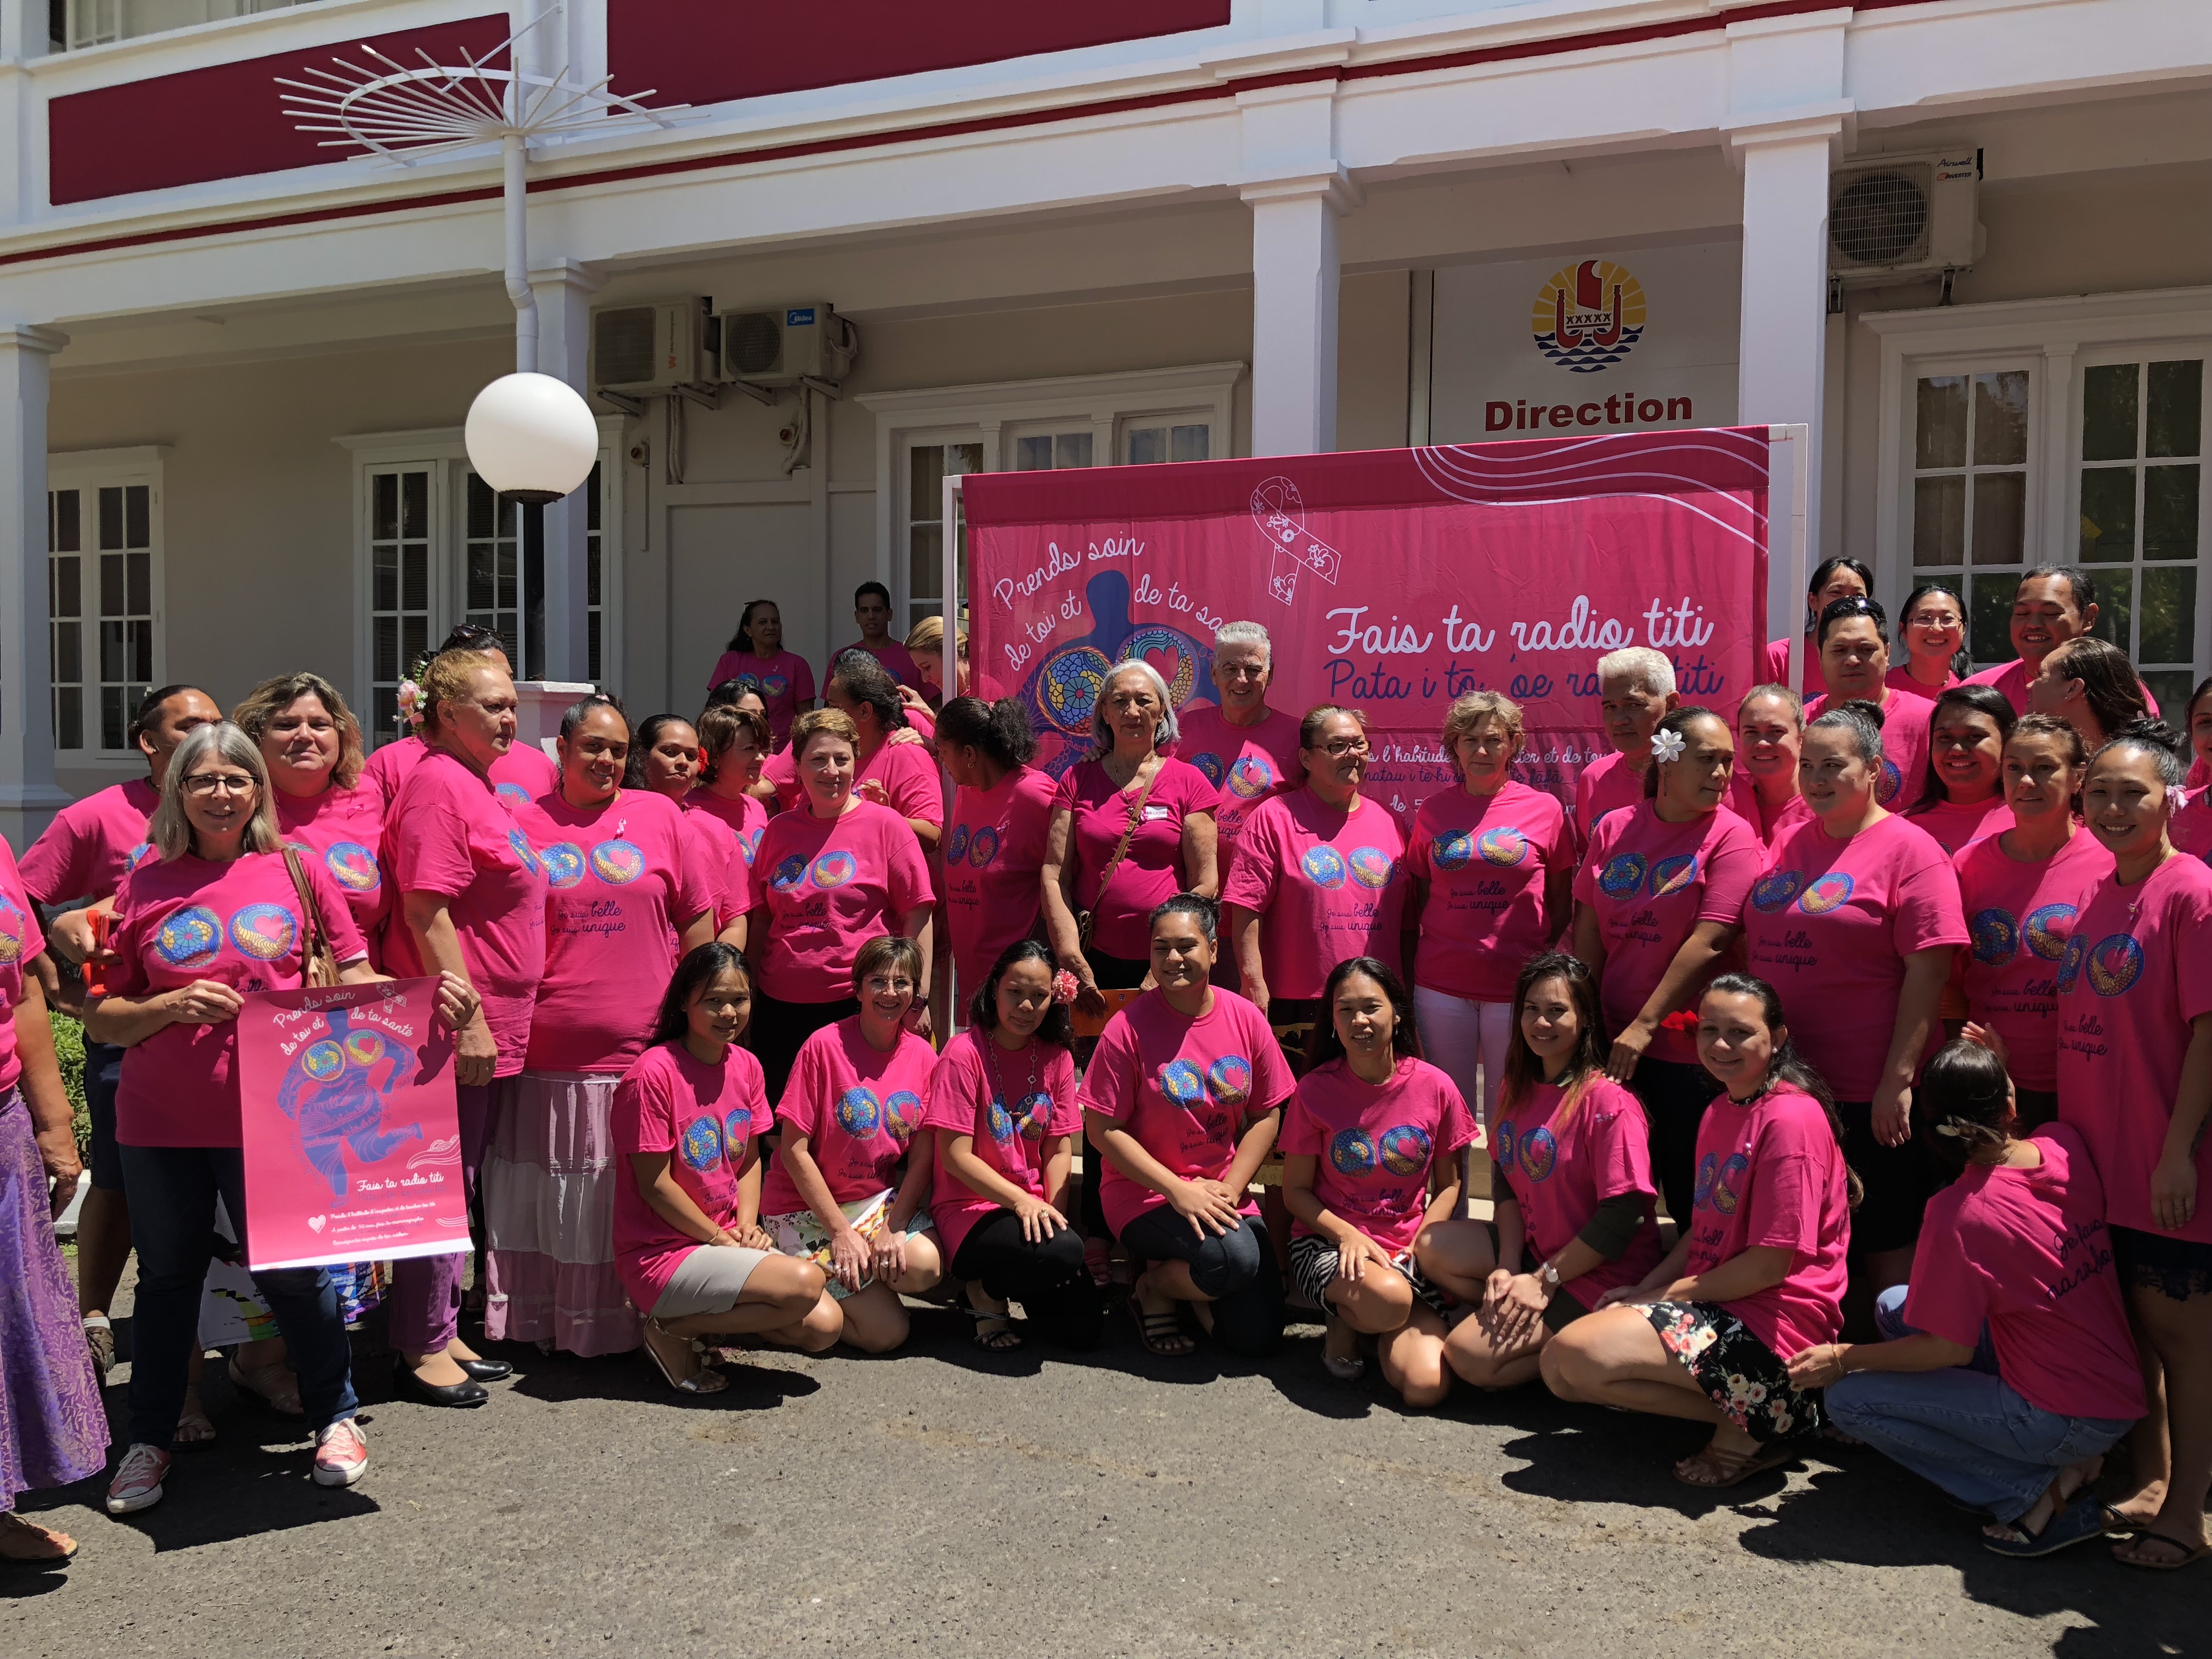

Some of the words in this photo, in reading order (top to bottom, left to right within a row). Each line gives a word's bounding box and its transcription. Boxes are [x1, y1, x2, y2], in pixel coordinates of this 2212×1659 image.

[1937, 156, 1973, 168] Airwell
[1485, 392, 1692, 432] Direction
[993, 541, 1081, 611] Prends
[1088, 530, 1145, 561] soin
[1005, 643, 1031, 672] de
[1025, 610, 1057, 645] toi
[1060, 589, 1082, 621] et
[1134, 573, 1163, 605] de
[1168, 581, 1195, 613] ta
[1325, 605, 1434, 654] Fais
[1442, 604, 1496, 653] ta
[1510, 595, 1635, 652] radio
[1642, 595, 1715, 647] titi
[1323, 658, 1412, 699] Pata
[1422, 665, 1437, 698] i
[1382, 744, 1453, 763] l'habitude
[1544, 746, 1559, 764] et
[1562, 744, 1582, 764] de
[1418, 766, 1432, 783] te
[1217, 808, 1243, 823] belle
[1477, 880, 1506, 895] belle
[591, 900, 623, 917] belle
[805, 902, 827, 917] belle
[1353, 902, 1379, 917] belle
[1470, 900, 1510, 916] unique
[1631, 910, 1659, 927] belle
[582, 921, 626, 939] unique
[1347, 921, 1383, 936] unique
[1784, 930, 1813, 949] belle
[1775, 954, 1818, 973] unique
[2023, 979, 2057, 996] belle
[273, 996, 323, 1029] Prends
[325, 989, 356, 1004] soin
[2013, 1002, 2058, 1019] uniqu
[280, 1041, 298, 1056] de
[292, 1026, 312, 1042] toi
[313, 1015, 324, 1030] et
[351, 1006, 366, 1020] de
[368, 1008, 382, 1022] ta
[381, 1017, 414, 1037] santé
[2078, 1013, 2103, 1036] belle
[2072, 1039, 2108, 1063] unique
[1207, 1112, 1228, 1130] belle
[357, 1179, 384, 1192] Fais
[385, 1177, 398, 1189] ta
[400, 1172, 428, 1187] radio
[428, 1171, 444, 1183] titi
[1701, 1226, 1724, 1246] bell
